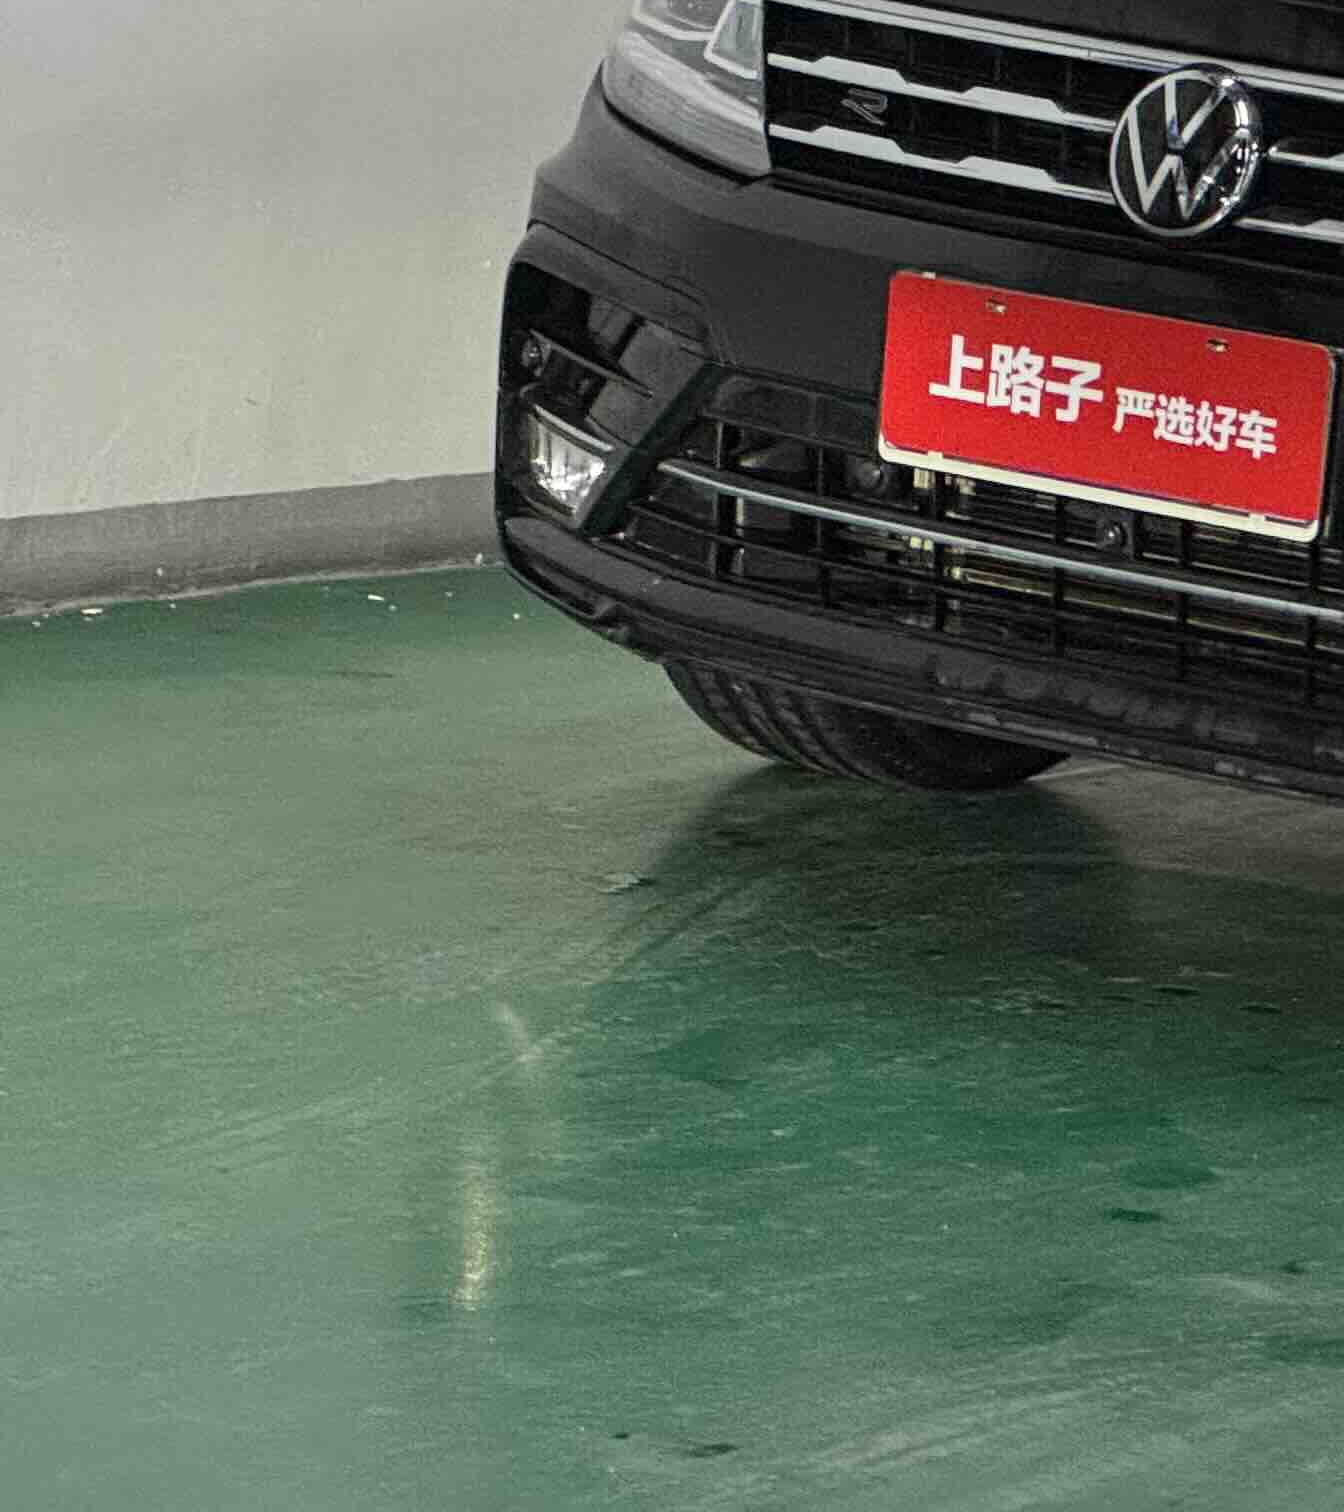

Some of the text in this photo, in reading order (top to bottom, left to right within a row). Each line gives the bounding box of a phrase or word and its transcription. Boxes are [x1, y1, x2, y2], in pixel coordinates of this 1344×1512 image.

[929, 334, 1278, 459] 上路子 严选好车
